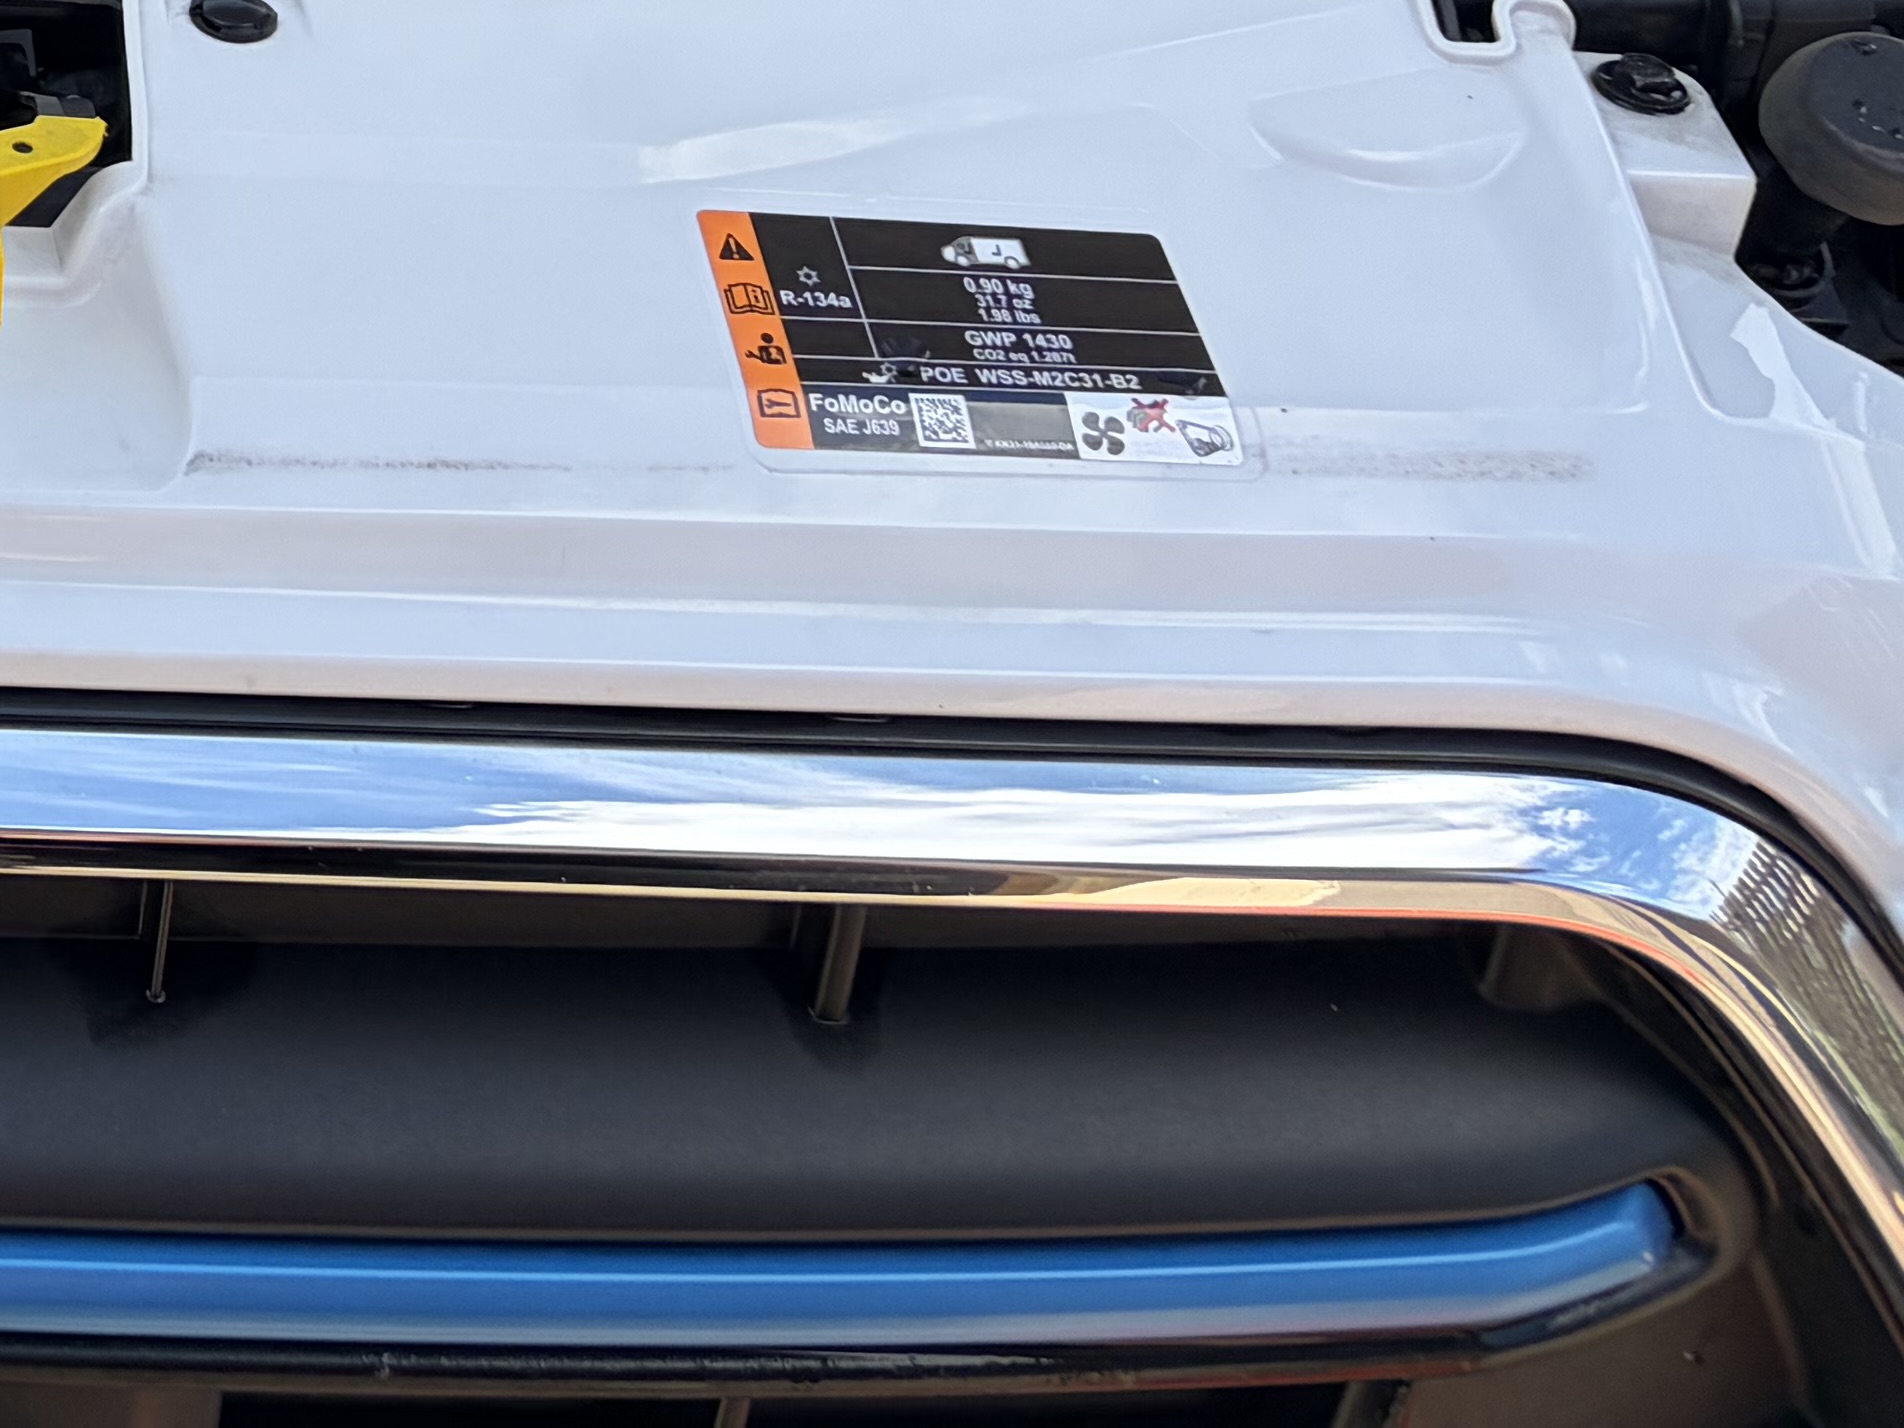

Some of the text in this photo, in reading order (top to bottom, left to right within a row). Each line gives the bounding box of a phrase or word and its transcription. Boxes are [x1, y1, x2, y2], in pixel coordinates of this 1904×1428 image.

[963, 278, 1035, 299] 0.90 kg
[780, 289, 853, 308] R-134a
[976, 294, 1034, 310] 31.7 oz
[978, 308, 1041, 324] 1.98 lbs
[964, 330, 1073, 350] GWP 1430
[973, 348, 1007, 361] CO2
[1009, 352, 1030, 363] eq
[919, 366, 1143, 390] POE WSS-M2C31-B2
[808, 393, 907, 414] FoMoCo
[823, 418, 901, 436] SAE J639
